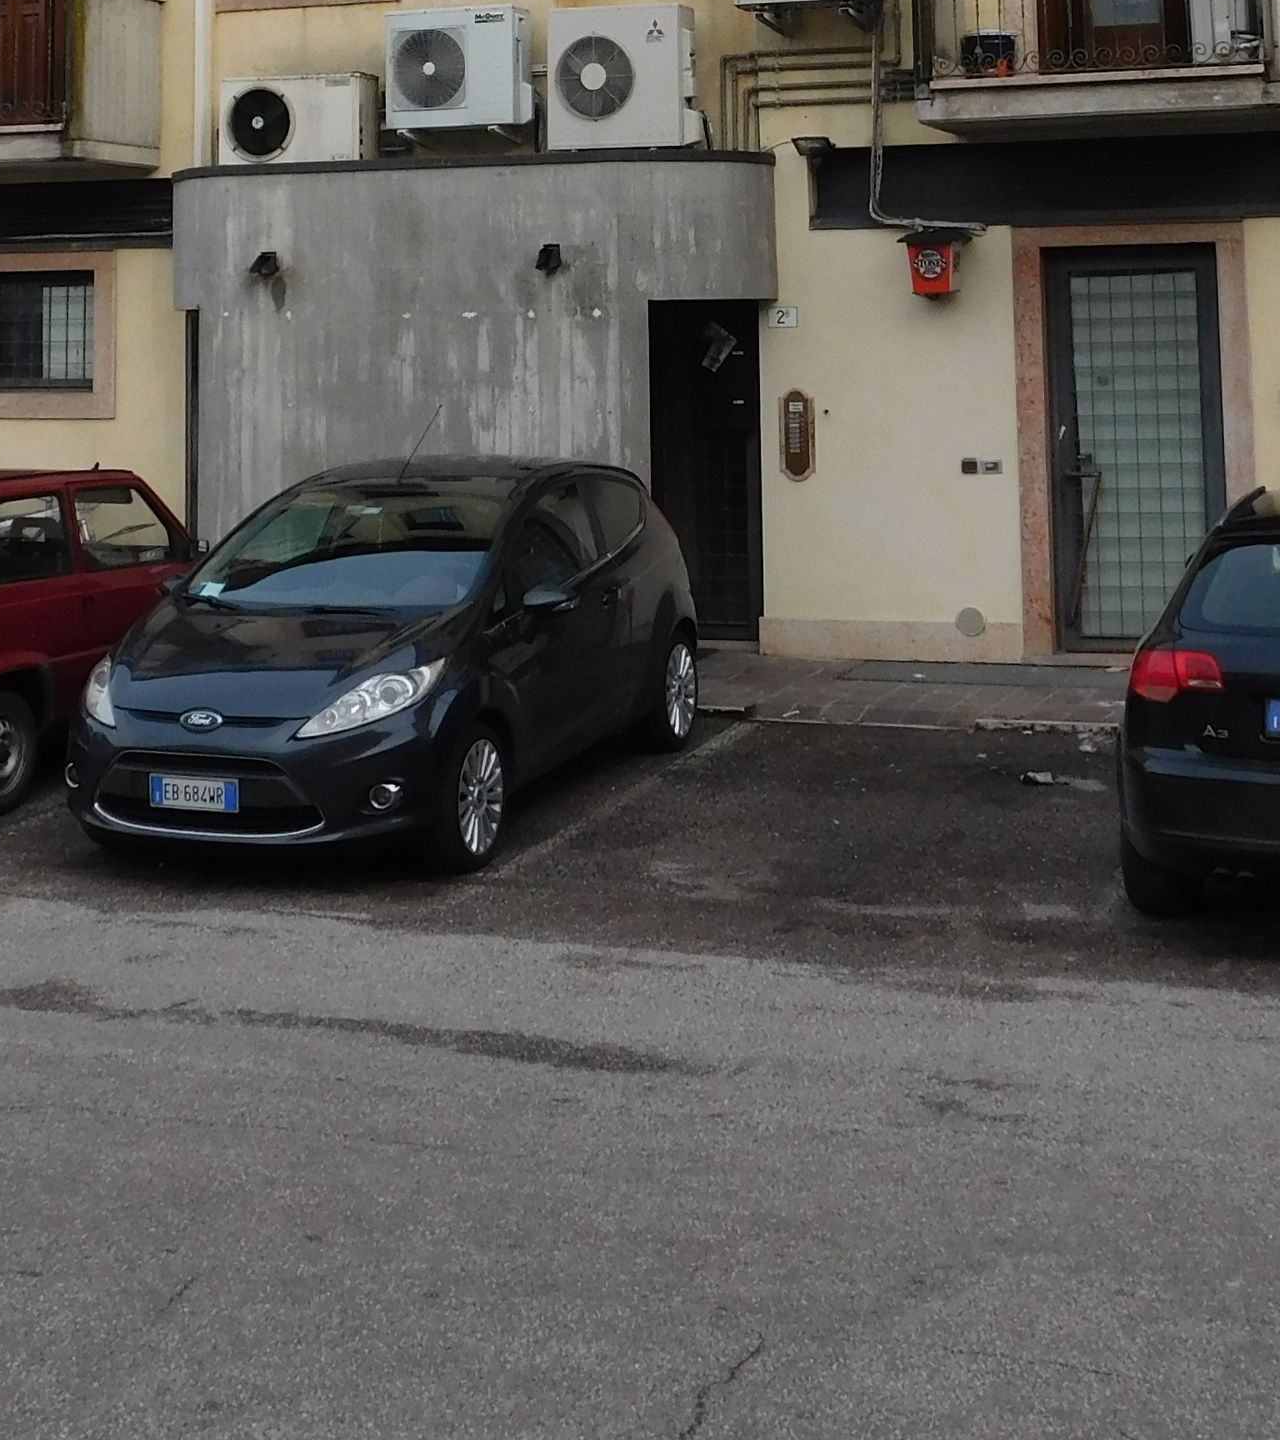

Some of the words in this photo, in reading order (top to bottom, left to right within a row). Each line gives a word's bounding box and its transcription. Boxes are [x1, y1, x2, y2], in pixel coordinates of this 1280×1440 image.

[1202, 725, 1229, 739] A3
[163, 783, 179, 801] EB
[184, 785, 224, 804] 684WR
